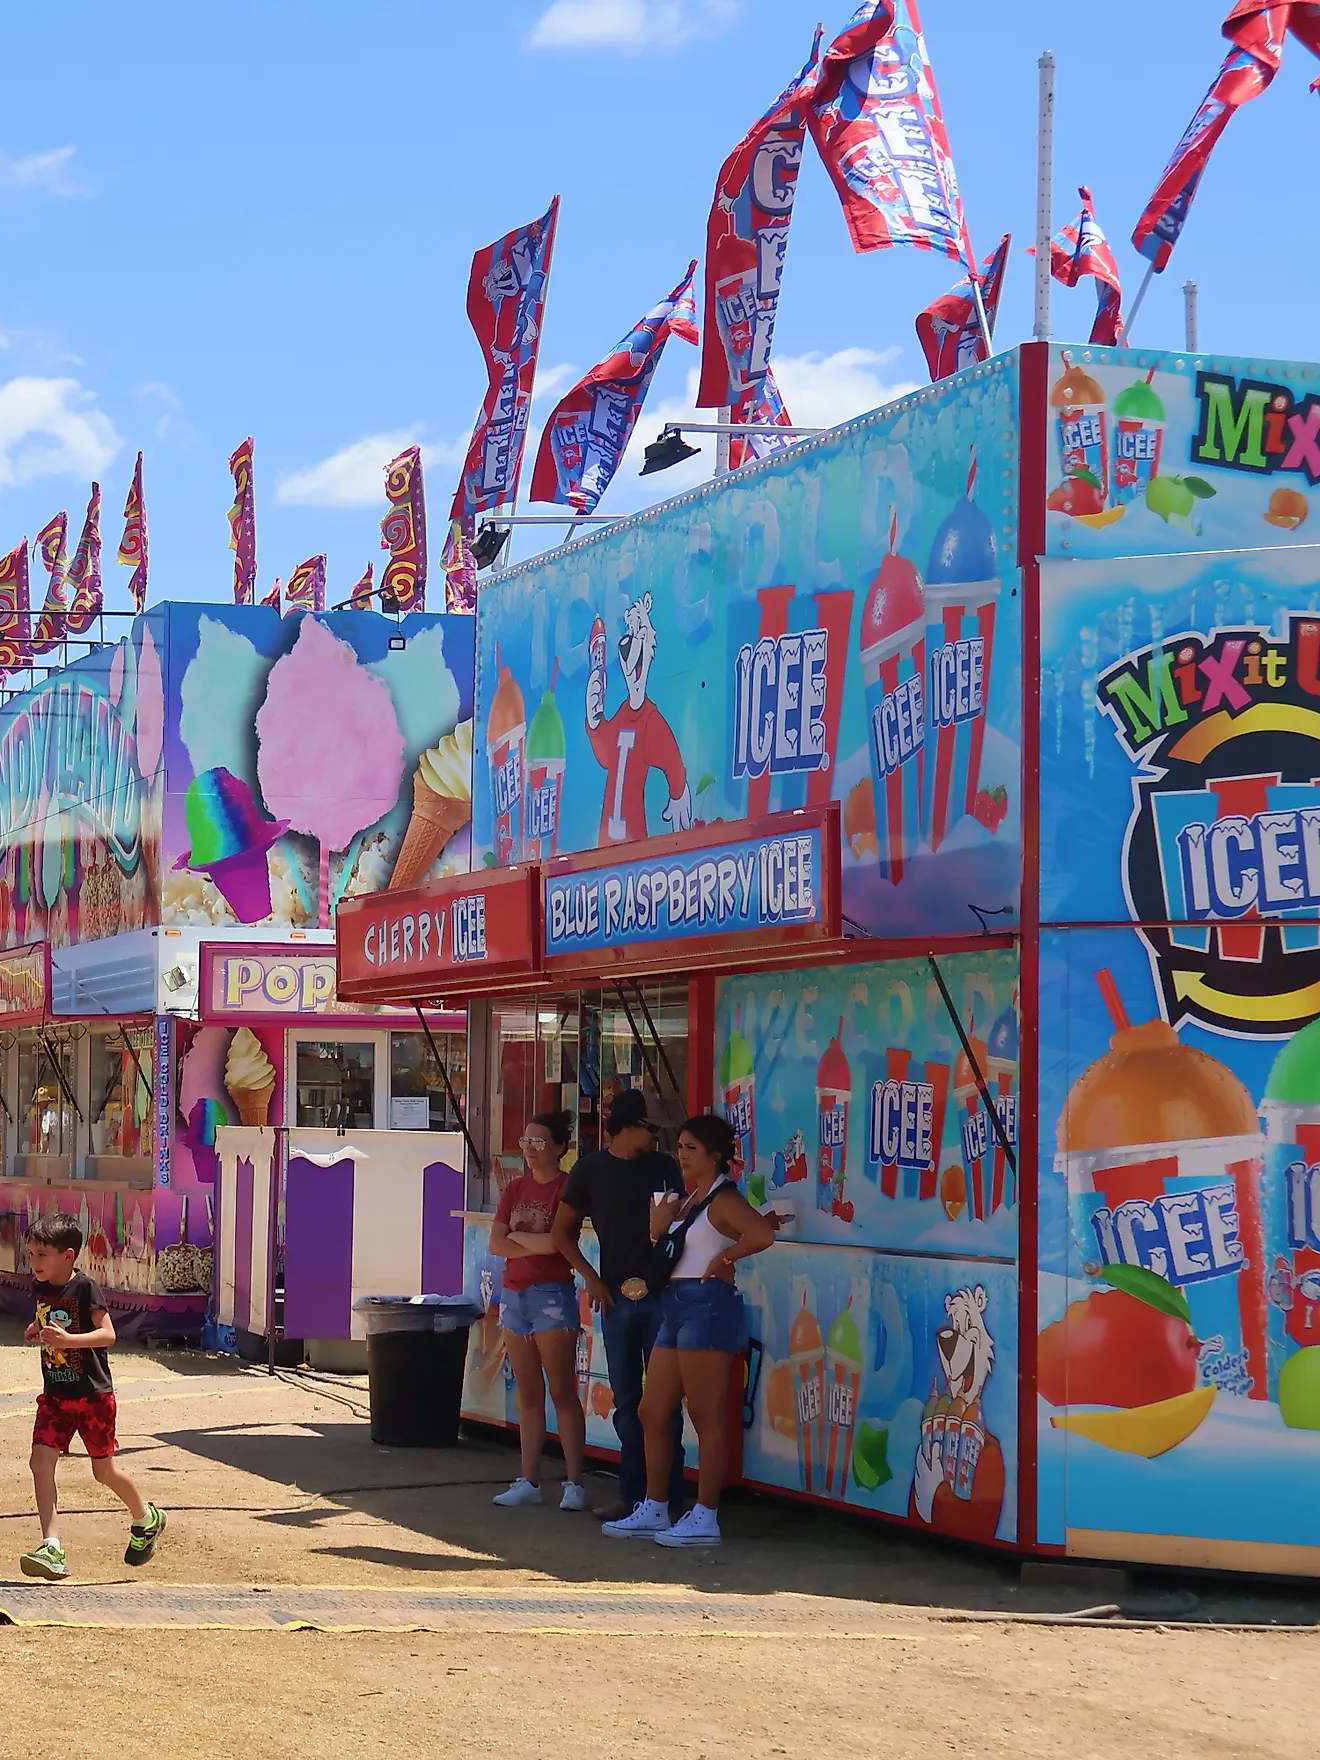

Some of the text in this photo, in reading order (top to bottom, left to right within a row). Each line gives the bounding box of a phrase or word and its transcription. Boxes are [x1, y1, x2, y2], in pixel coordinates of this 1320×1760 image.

[1116, 431, 1157, 460] ICEE
[733, 628, 828, 779] ICEE
[931, 637, 984, 729] ICEE
[872, 673, 926, 780] ICEE
[494, 756, 522, 819] ICEE
[528, 784, 557, 841] ICEE
[551, 835, 814, 941] BLUE RASPBERRY ICEE
[364, 894, 488, 967] CHERRY ICEE
[819, 1111, 846, 1148] ICEE
[870, 1079, 935, 1171] ICEE
[1091, 1182, 1250, 1289] ICEE
[795, 1376, 821, 1428] ICEE
[826, 1383, 854, 1429] ICEE
